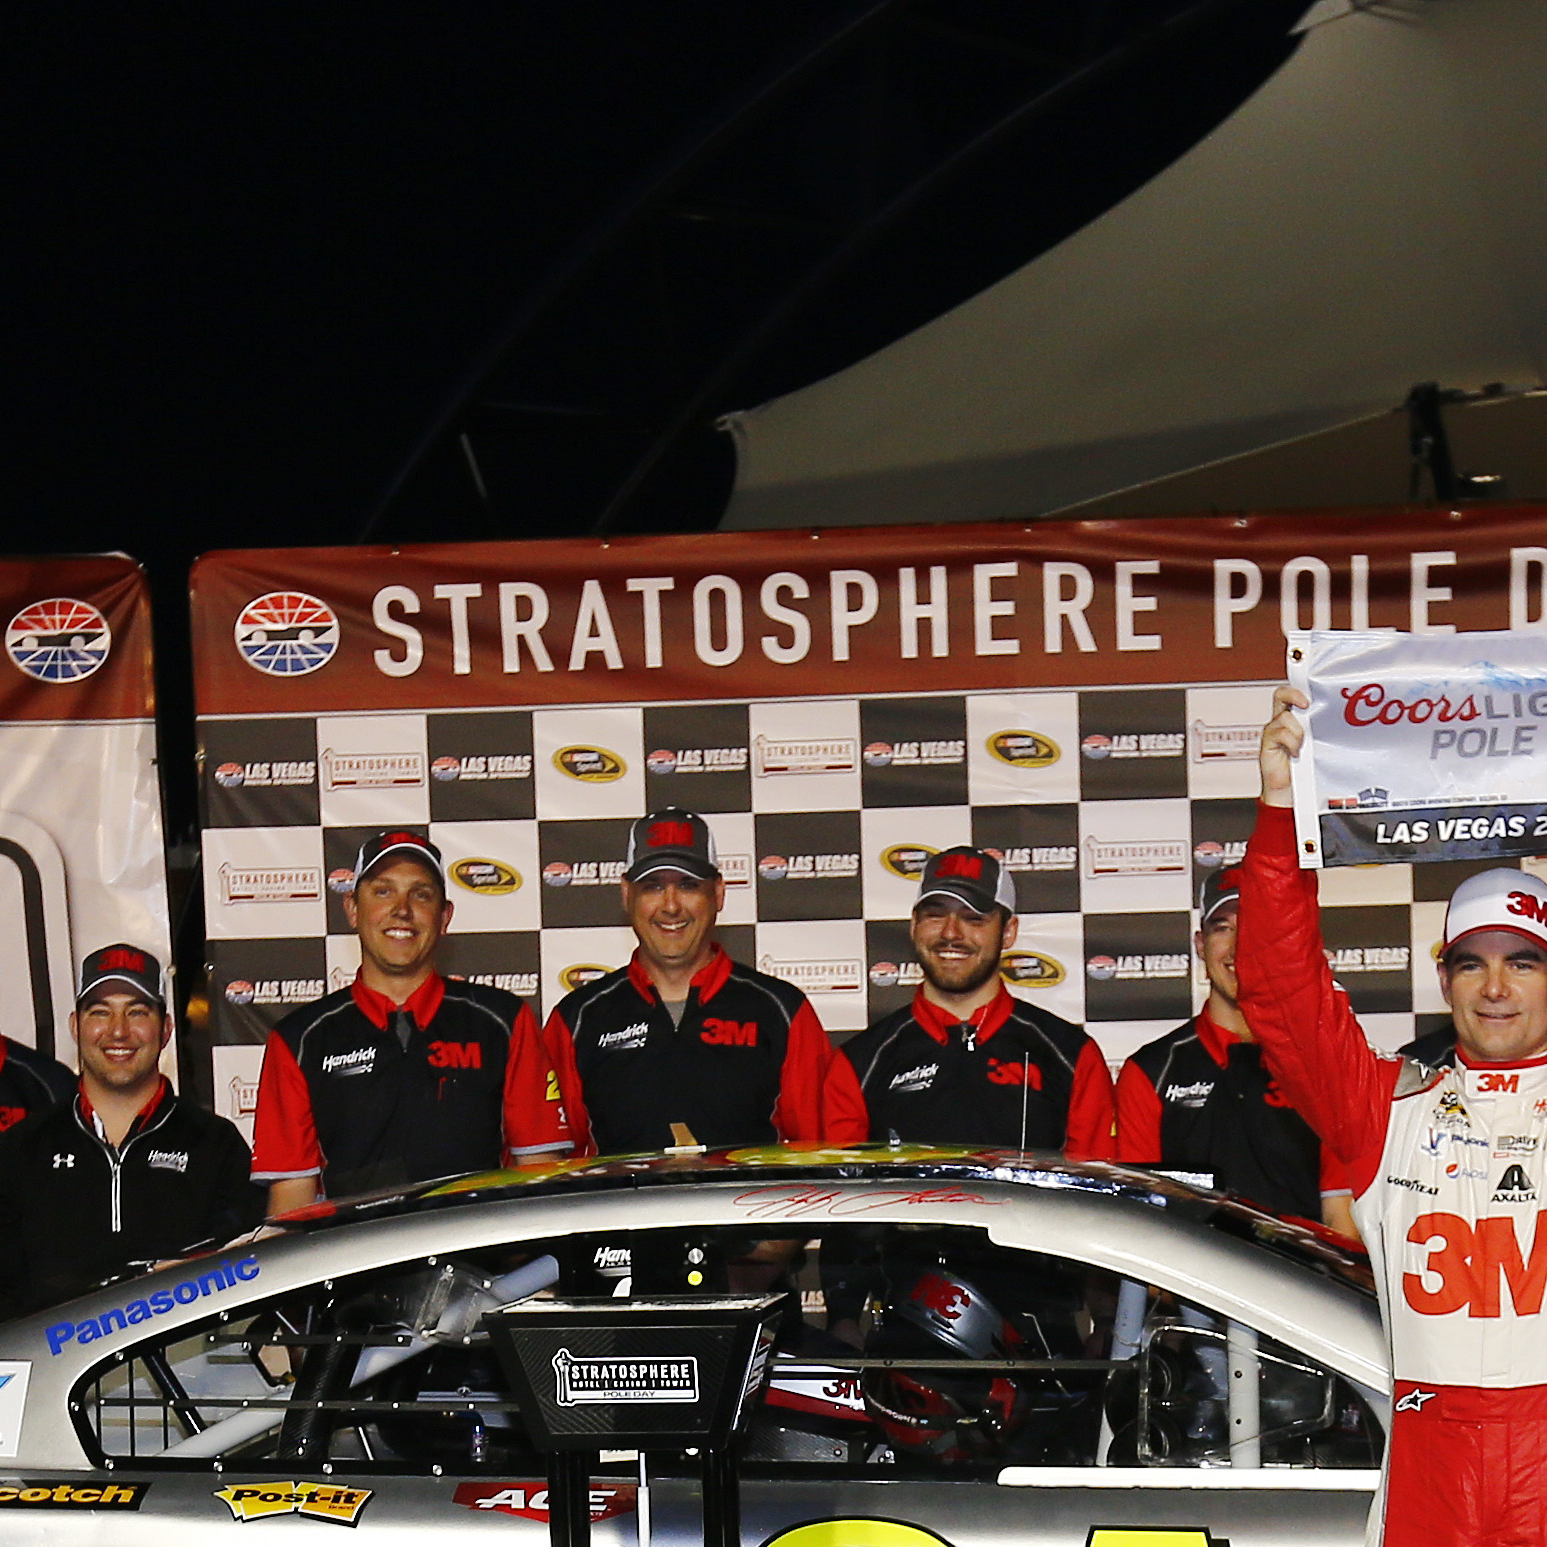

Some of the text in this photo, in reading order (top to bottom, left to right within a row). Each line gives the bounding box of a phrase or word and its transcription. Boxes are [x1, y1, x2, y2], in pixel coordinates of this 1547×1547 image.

[372, 561, 1162, 678] STRATOSPHERE
[1213, 552, 1456, 648] POLE
[1342, 683, 1481, 729] Coors
[1430, 726, 1537, 759] POLE
[246, 761, 316, 778] LAS VEGAS
[334, 757, 419, 772] STRATOSPHERE
[1376, 821, 1429, 844] LAS
[1437, 817, 1526, 841] VEGAS
[231, 871, 317, 886] STRATOSPHERE
[933, 854, 983, 880] 3M
[98, 950, 144, 974] 3M
[255, 979, 325, 997] LAS VEGAS
[700, 1017, 758, 1047] 3M
[323, 1046, 376, 1072] Hendrick
[427, 1041, 482, 1069] 3M
[987, 1057, 1042, 1091] 3M
[1477, 1073, 1520, 1093] 3M
[46, 1257, 260, 1356] Panasonic
[571, 1364, 690, 1379] STRATOSPHERE
[232, 1488, 358, 1506] Post-it
